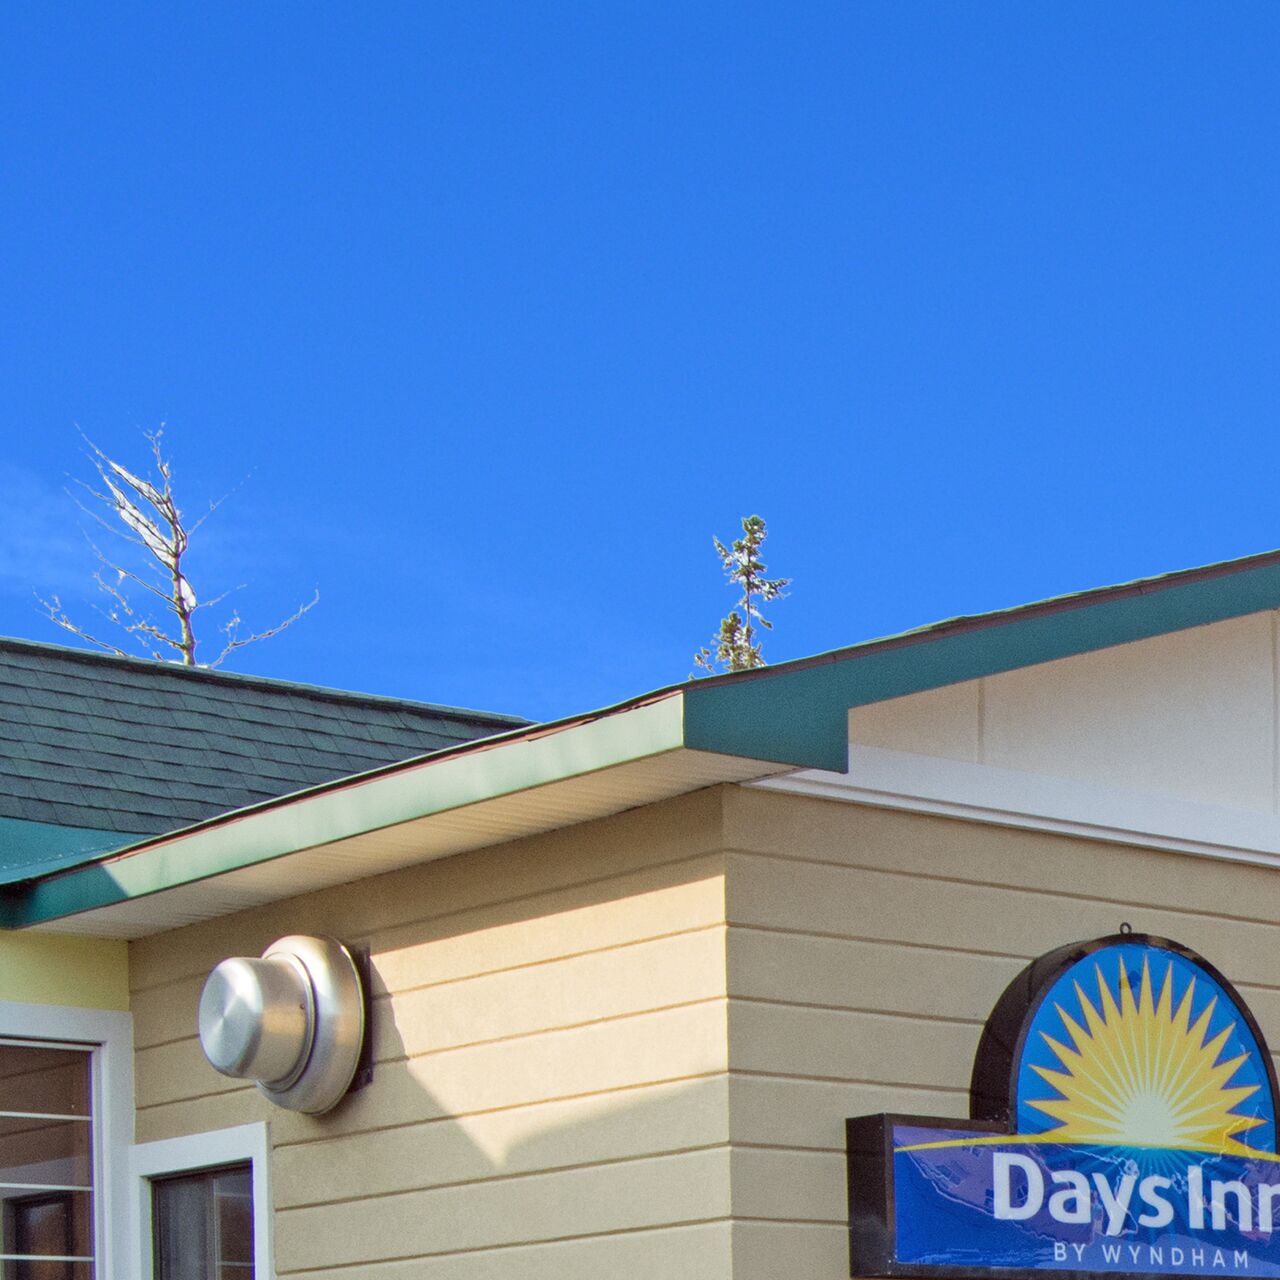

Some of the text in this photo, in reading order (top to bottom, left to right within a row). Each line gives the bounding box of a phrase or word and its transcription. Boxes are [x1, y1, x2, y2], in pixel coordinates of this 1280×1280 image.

[992, 1151, 1175, 1236] Days
[1053, 1242, 1250, 1269] BY WYNDHAM
